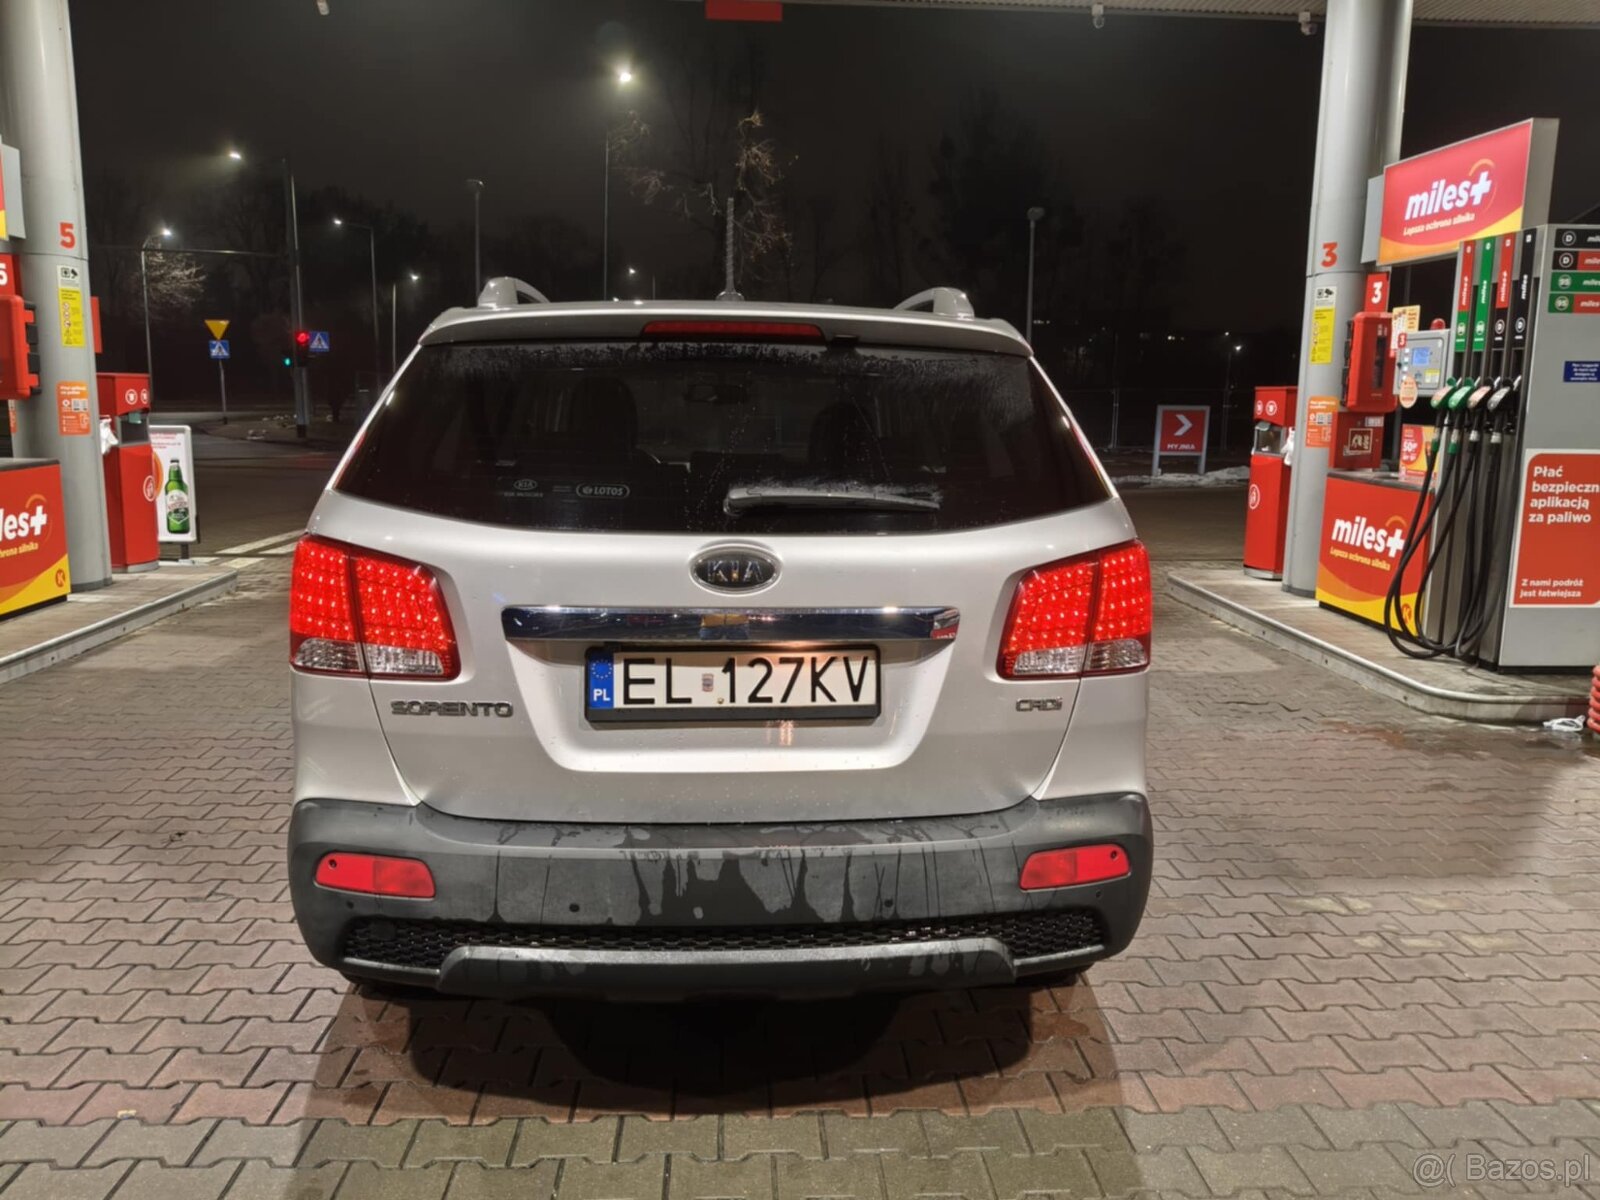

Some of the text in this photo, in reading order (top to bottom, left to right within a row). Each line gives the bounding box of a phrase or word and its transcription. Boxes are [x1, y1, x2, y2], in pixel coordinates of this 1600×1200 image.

[1404, 171, 1492, 221] miles+
[59, 221, 76, 249] 5
[1321, 241, 1338, 268] 3
[1371, 281, 1383, 304] 3
[1533, 465, 1564, 478] Płać
[594, 486, 623, 496] LOTOS
[1531, 480, 1600, 495] bezpieczn
[1530, 496, 1590, 511] aplikacją
[1528, 511, 1592, 525] za paliwo
[1331, 515, 1405, 558] miles+
[707, 560, 763, 582] KIA
[1521, 578, 1584, 589] Z nami podróż
[1519, 589, 1581, 599] jest łatwiejsza
[623, 655, 869, 705] EL 127KV
[593, 688, 611, 702] PL
[389, 700, 514, 718] SORENTO
